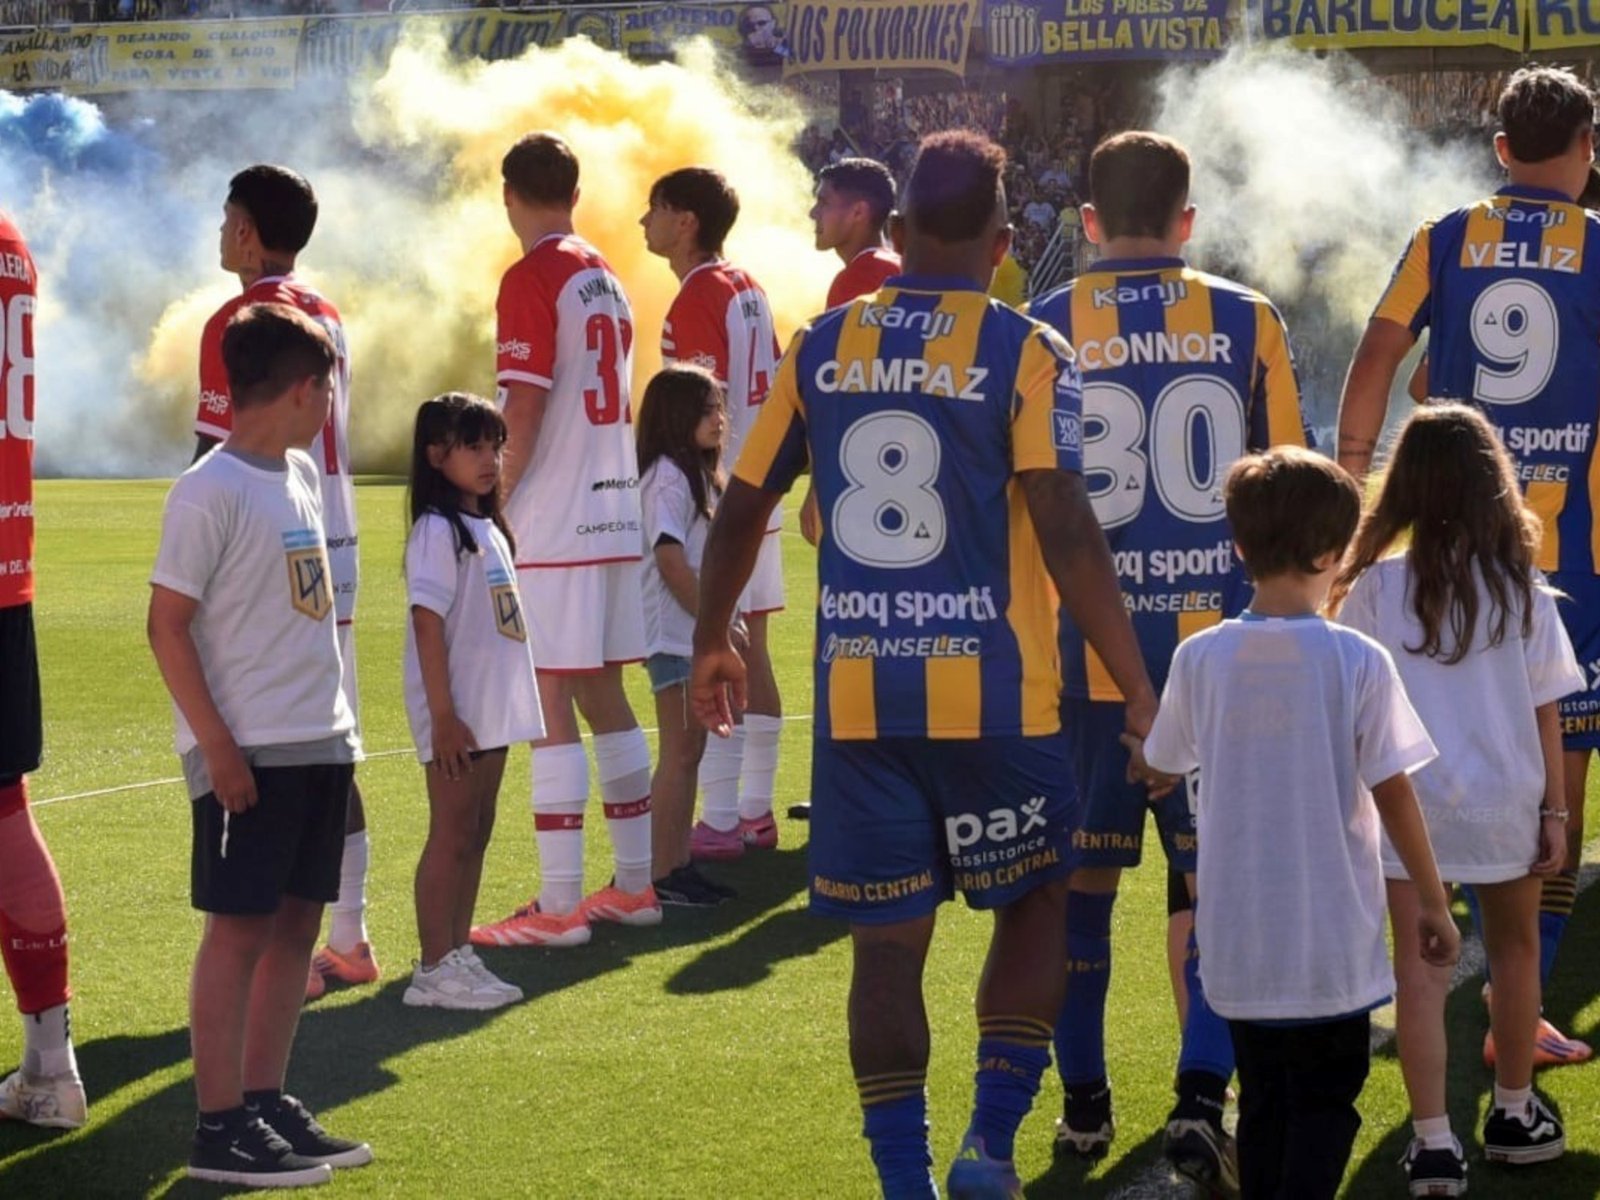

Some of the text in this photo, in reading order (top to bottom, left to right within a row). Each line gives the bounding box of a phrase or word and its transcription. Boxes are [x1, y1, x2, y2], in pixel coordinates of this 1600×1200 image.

[117, 31, 191, 44] DEJANDO
[787, 2, 970, 65] LOS POLVORINES
[1042, 17, 1223, 54] BELLA VISTA
[13, 60, 31, 81] LA
[1487, 207, 1565, 229] kanji
[1469, 242, 1577, 273] VELIZ
[1093, 281, 1188, 309] kanji
[860, 303, 955, 340] kanji
[1079, 331, 1232, 370] CONNOR
[1470, 278, 1559, 405] 9
[815, 358, 989, 402] CAMPAZ
[1508, 423, 1591, 456] sportif
[831, 409, 947, 569] 8
[838, 637, 981, 657] TRANSELEC
[945, 796, 1047, 856] pax
[950, 835, 1045, 868] assistance
[996, 847, 1060, 885] CENTRAL
[864, 868, 934, 901] CENTRAL
